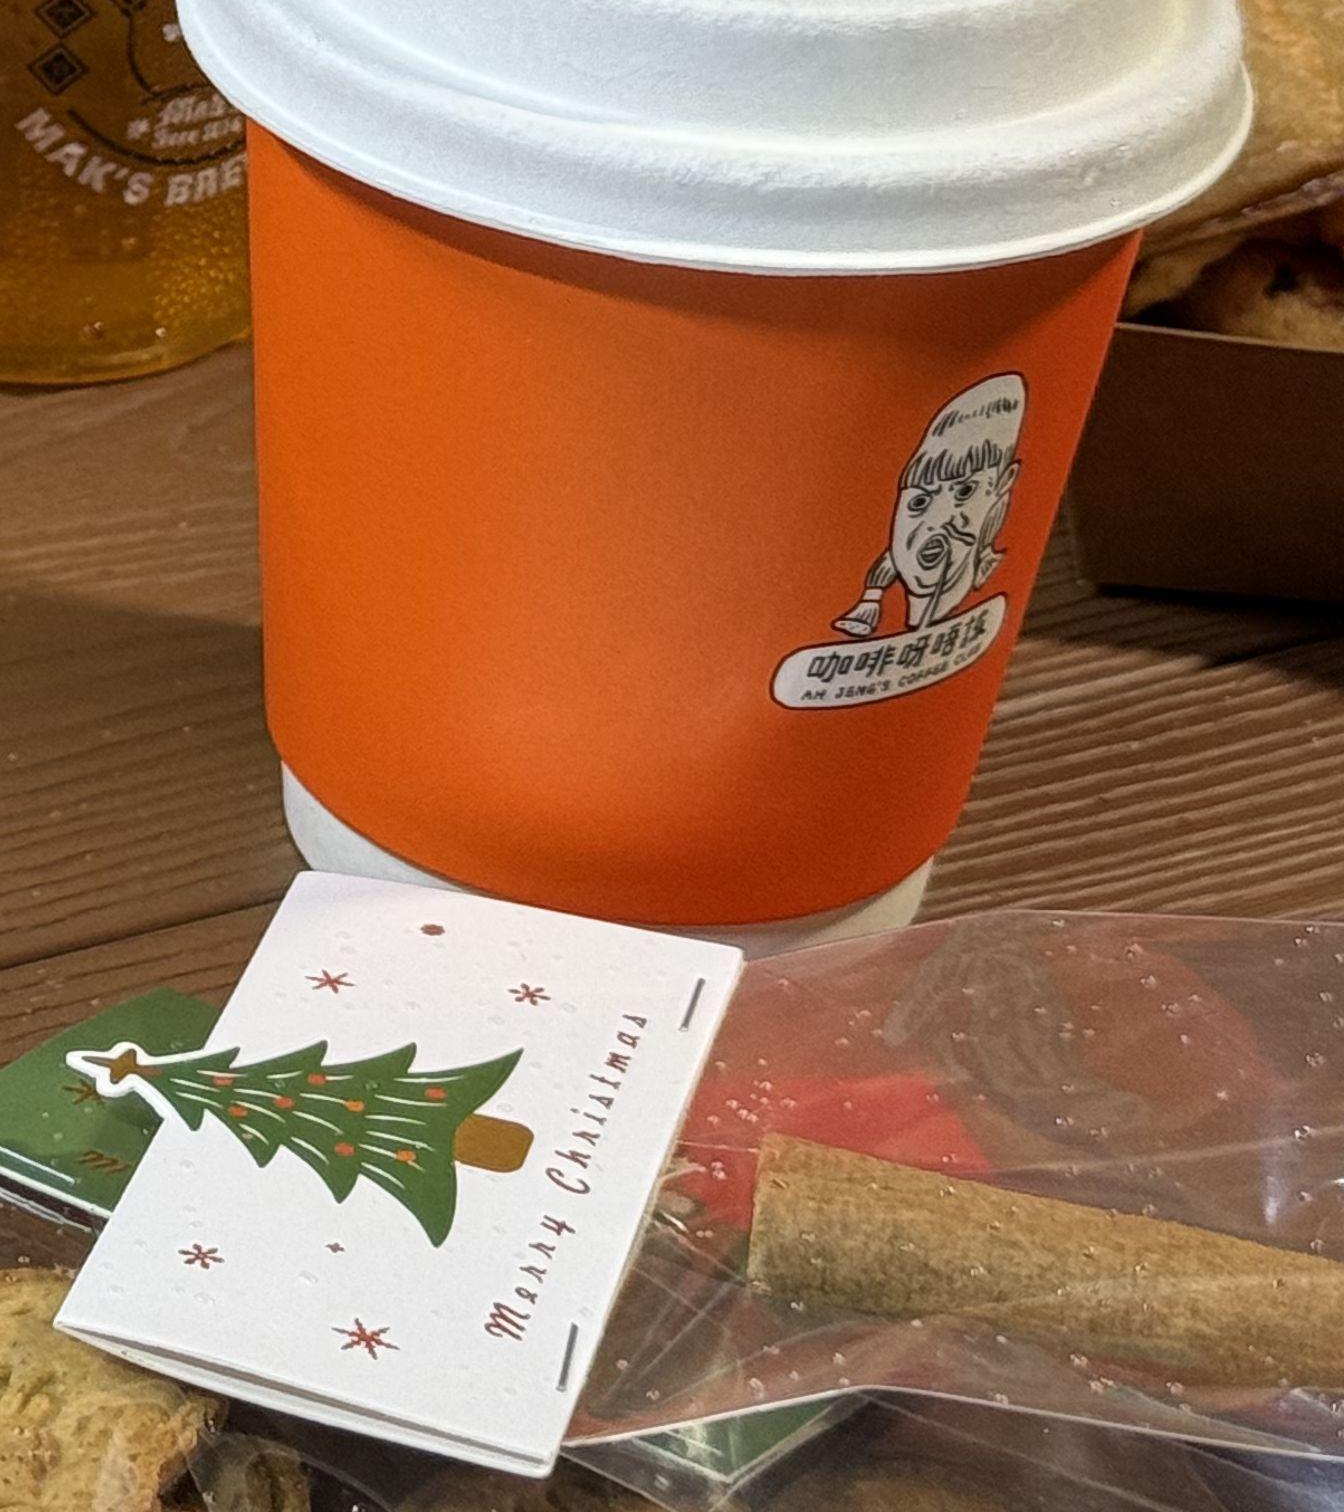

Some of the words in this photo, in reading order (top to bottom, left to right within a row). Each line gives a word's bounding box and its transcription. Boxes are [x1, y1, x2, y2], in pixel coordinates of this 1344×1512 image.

[15, 107, 154, 206] MAK'S
[483, 1214, 577, 1341] Merry
[544, 1013, 649, 1195] Christmas
